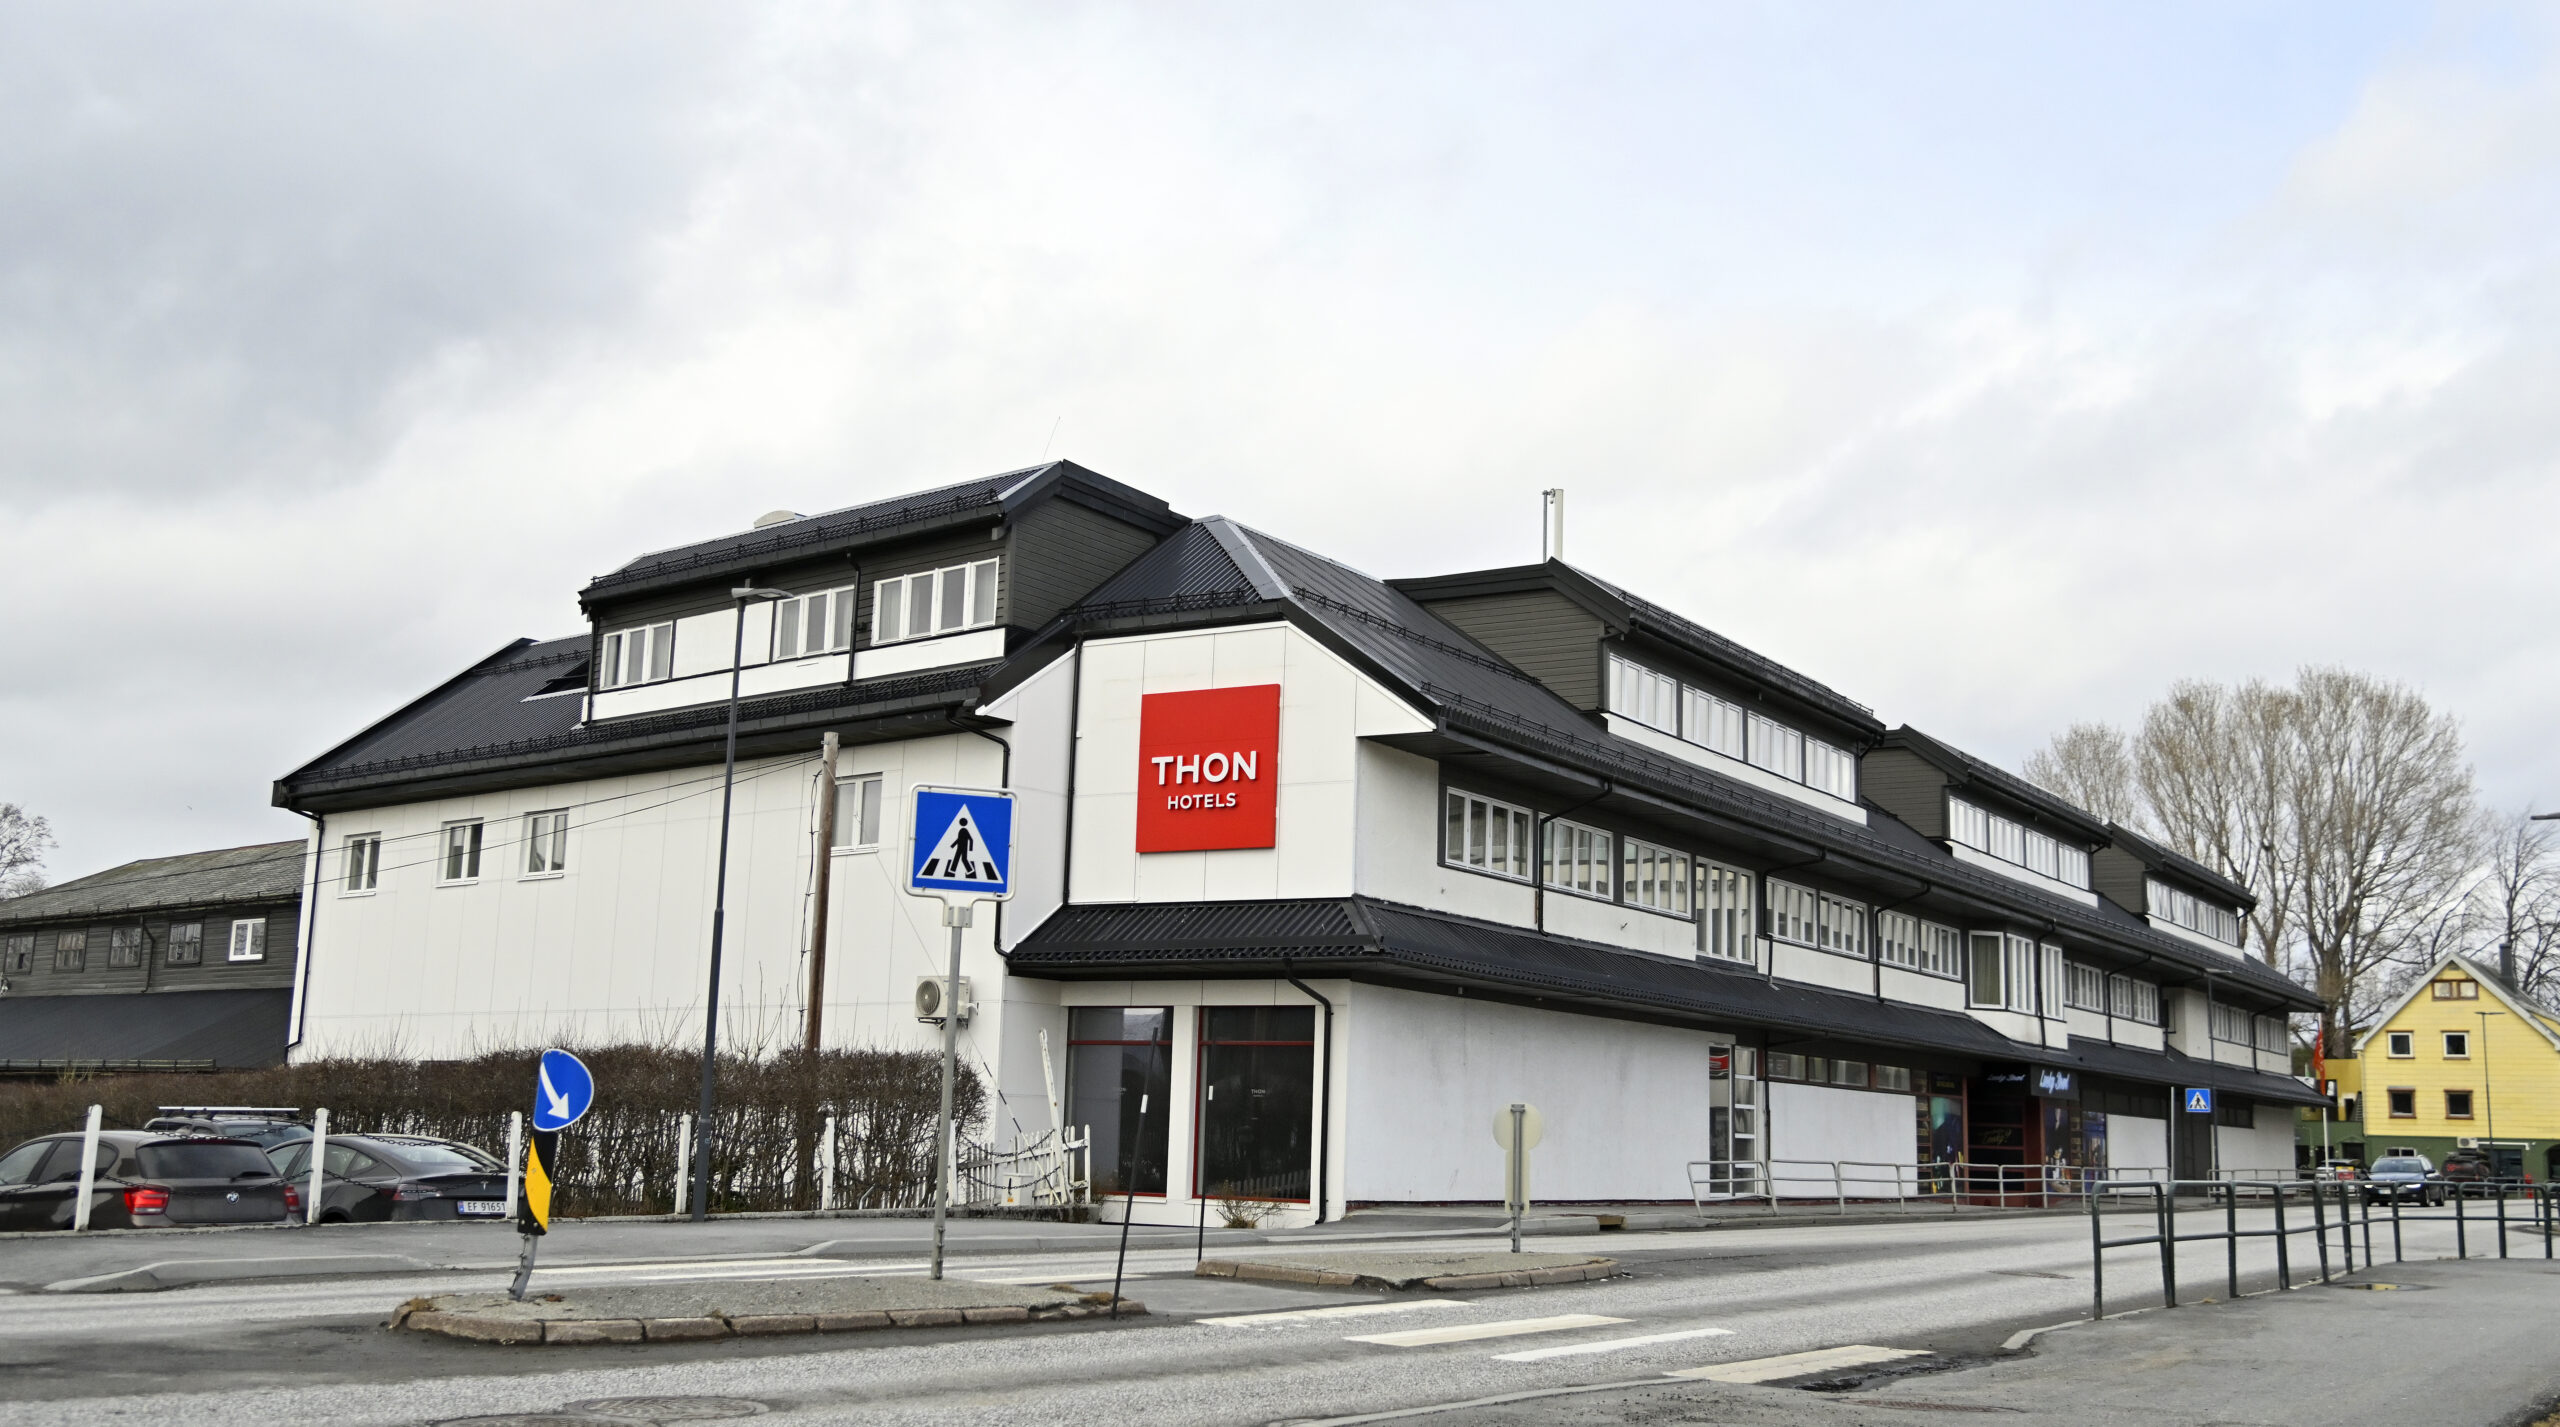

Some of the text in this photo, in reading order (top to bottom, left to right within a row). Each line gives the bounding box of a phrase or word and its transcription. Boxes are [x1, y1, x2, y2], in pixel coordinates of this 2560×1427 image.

[1151, 750, 1257, 786] THON
[1167, 793, 1237, 810] HOTELS
[467, 1202, 506, 1212] EF 91651
